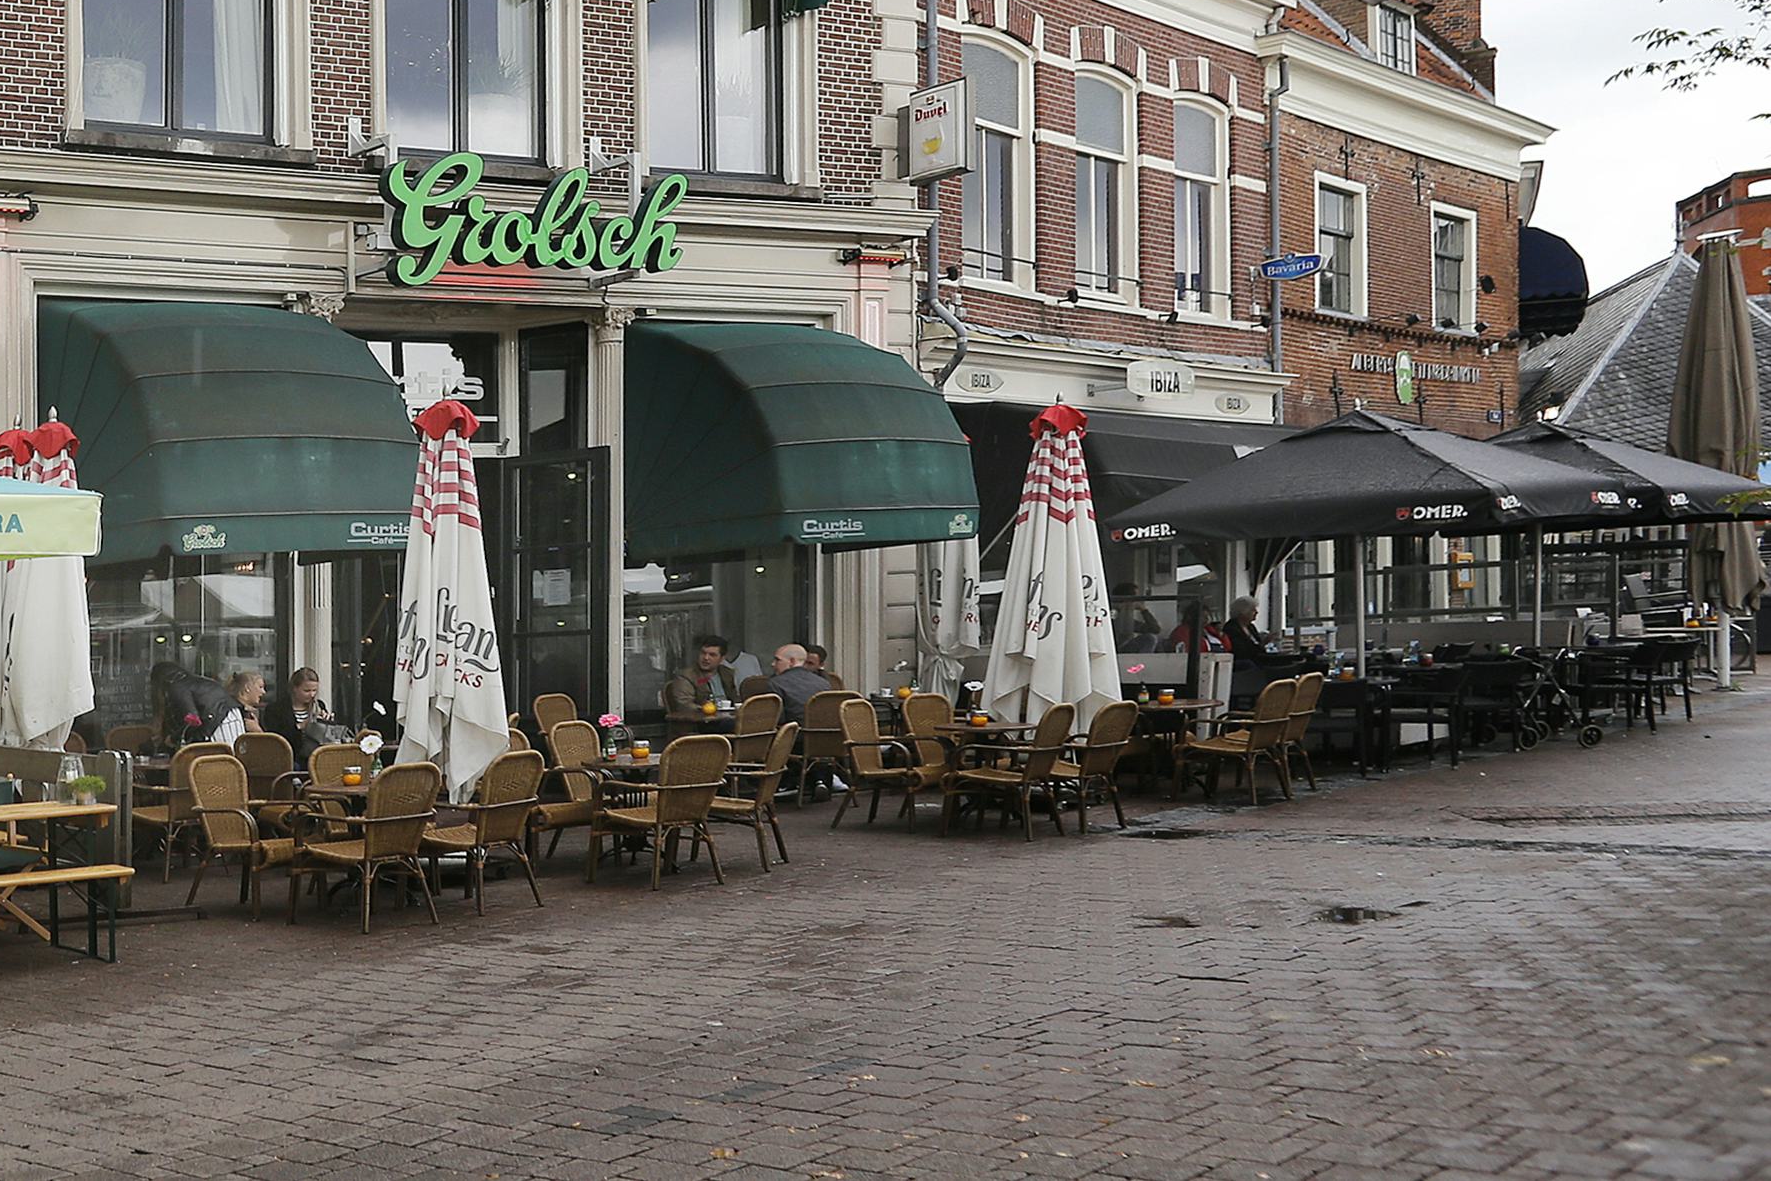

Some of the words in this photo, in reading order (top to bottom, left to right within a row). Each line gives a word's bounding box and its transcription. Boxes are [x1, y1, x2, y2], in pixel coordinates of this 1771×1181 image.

[915, 101, 948, 123] Duvel
[384, 151, 689, 286] Grolsch
[1267, 260, 1314, 276] Bavaria
[971, 373, 992, 388] IBIZA
[1150, 371, 1180, 393] IBIZA
[350, 522, 410, 537] Curtis
[803, 518, 864, 533] Curtis
